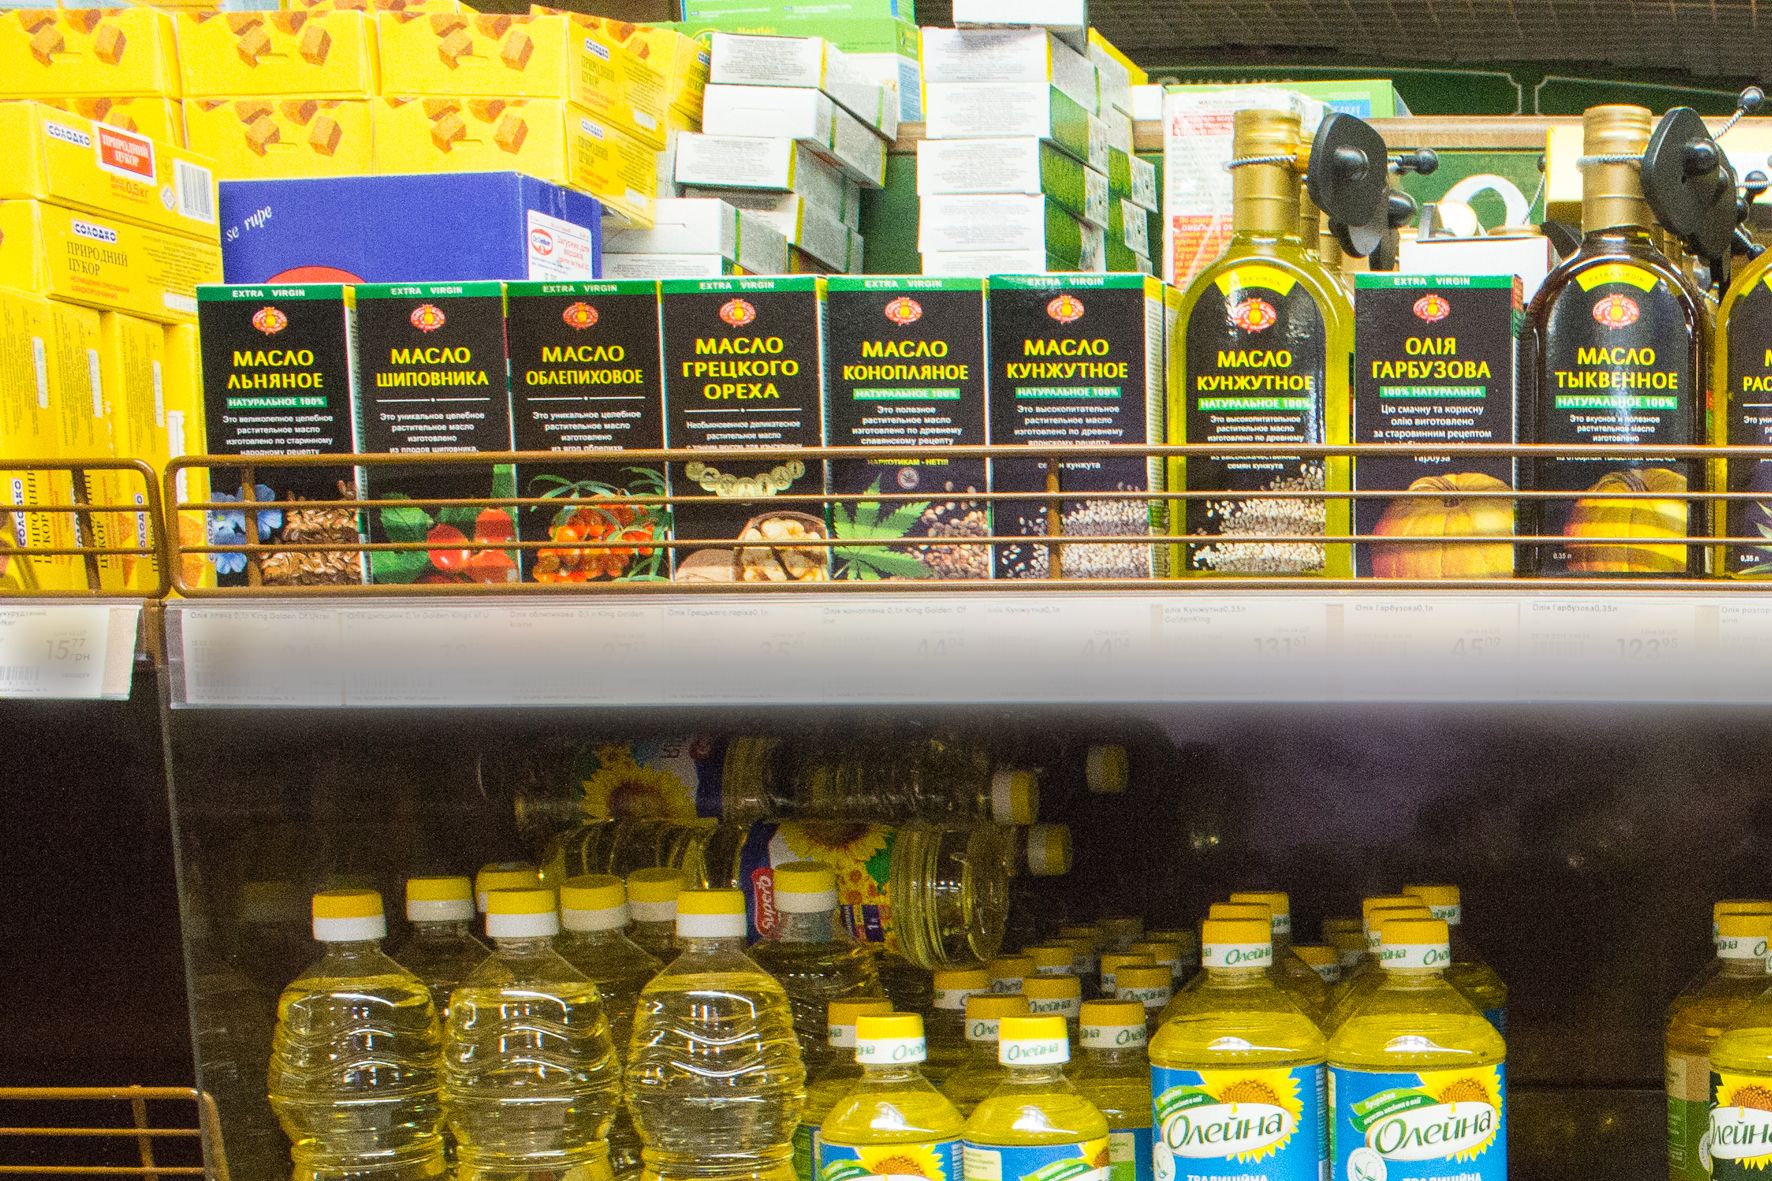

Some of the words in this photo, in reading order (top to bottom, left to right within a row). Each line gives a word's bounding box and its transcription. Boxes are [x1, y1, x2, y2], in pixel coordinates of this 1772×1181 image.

[47, 123, 92, 148] СОЛОДКО
[101, 134, 149, 158] ПРИРОДНИЙ
[114, 151, 141, 168] ЦУКОР
[74, 223, 117, 241] СОЛОДКО
[225, 226, 240, 242] se
[243, 204, 273, 229] rupe
[66, 241, 129, 267] ПРИРОДНИЙ
[68, 259, 101, 276] ЦУКОР
[1394, 277, 1427, 286] EXTRA
[1436, 276, 1470, 286] VIRGIN
[232, 289, 264, 298] EXTRA
[272, 288, 305, 297] VIRGIN
[542, 345, 625, 363] МАСЛО
[695, 337, 784, 355] МАСЛО
[861, 340, 948, 359] МАСЛО
[1024, 339, 1109, 357] МАСЛО
[1405, 337, 1456, 356] ОЛІЯ
[233, 350, 315, 367] МАСЛО
[391, 347, 471, 365] МАСЛО
[1217, 350, 1291, 369] МАСЛО
[1577, 347, 1656, 366] МАСЛО
[526, 369, 643, 386] ОБЛЕПИХОВОЕ
[682, 360, 799, 378] ГРЕЦКОГО
[843, 365, 968, 381] КОНОПЛЯНОЕ
[1007, 362, 1128, 380] КУНЖУТНОЕ
[1372, 361, 1491, 379] ГАРБУЗОВА
[227, 373, 324, 390] ЛЬНЯНОЕ
[376, 371, 490, 388] ШИПОВНИКА
[1198, 375, 1314, 391] КУНЖУТНОЕ
[1555, 371, 1678, 389] ТЫКВЕННОЕ
[703, 383, 780, 400] ОРЕХА
[1383, 387, 1410, 397] 100%
[1412, 387, 1482, 397] НАТУРАЛЬНА
[228, 398, 297, 407] НАТУРАЛЬНОЕ
[300, 397, 325, 406] 100%
[1381, 404, 1396, 415] Цю
[1397, 406, 1431, 416] смачну
[1433, 406, 1443, 415] та
[1445, 405, 1484, 416] корисну
[1391, 417, 1412, 427] олію
[1414, 417, 1475, 427] виготовлено
[1374, 430, 1384, 438] за
[1386, 429, 1445, 439] старовинним
[1447, 429, 1492, 440] рецептом
[1225, 947, 1273, 966] Олейна
[1167, 1113, 1284, 1151] Олейна
[1375, 1109, 1493, 1155] Олейна
